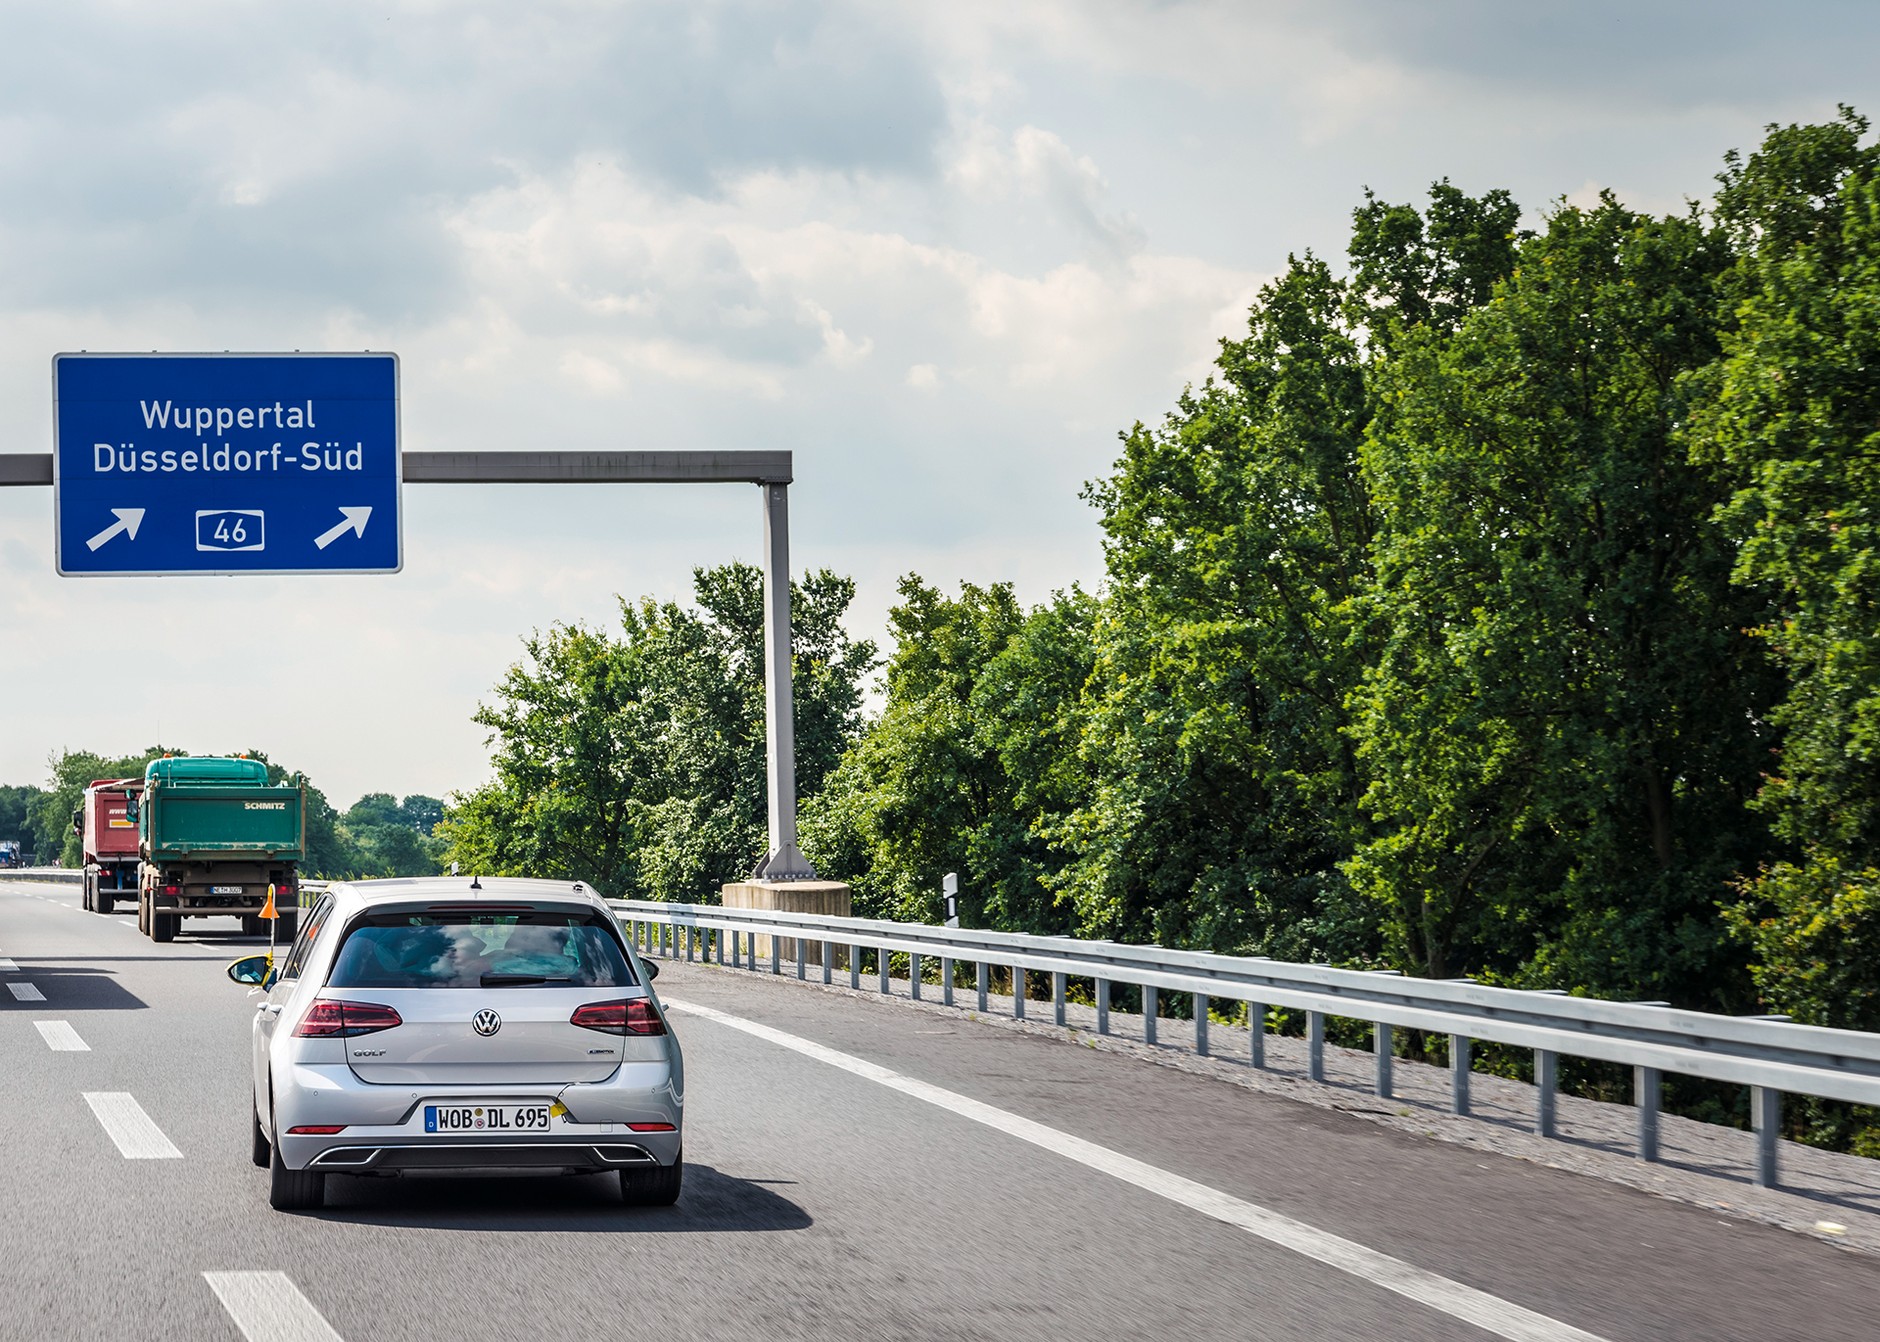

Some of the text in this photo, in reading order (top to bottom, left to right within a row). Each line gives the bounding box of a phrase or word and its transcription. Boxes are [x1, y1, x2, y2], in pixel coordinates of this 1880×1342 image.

[140, 399, 316, 436] Wuppertal
[93, 442, 363, 472] Düsseldorf-Süd
[213, 518, 247, 543] 46
[244, 802, 285, 810] SCHMITZ
[353, 1048, 387, 1057] GOLF
[438, 1109, 473, 1128] WOB
[487, 1108, 510, 1128] DL
[515, 1108, 548, 1128] 695
